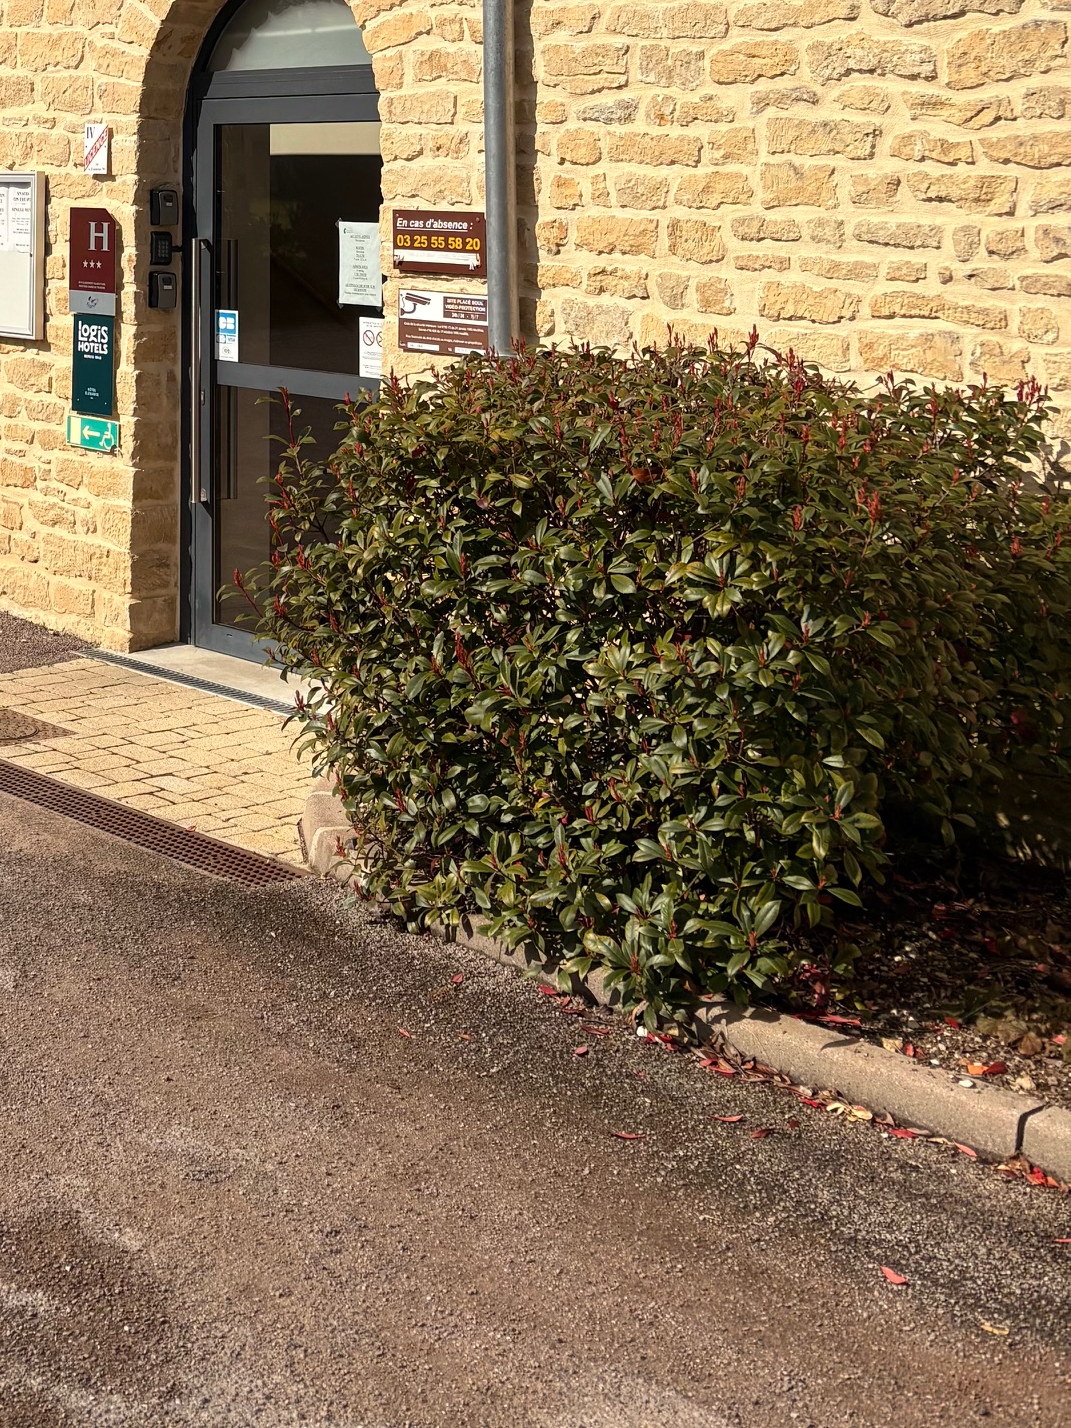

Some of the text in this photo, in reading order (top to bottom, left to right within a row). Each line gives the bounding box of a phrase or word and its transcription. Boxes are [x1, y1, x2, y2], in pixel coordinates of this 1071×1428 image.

[86, 126, 96, 139] IV
[84, 127, 108, 169] LICENCE
[396, 217, 408, 227] En
[409, 219, 424, 228] cas
[425, 218, 468, 230] d'absence
[88, 221, 110, 252] H
[396, 234, 481, 251] 03 25 55 58 20
[77, 341, 109, 355] HOTELS
